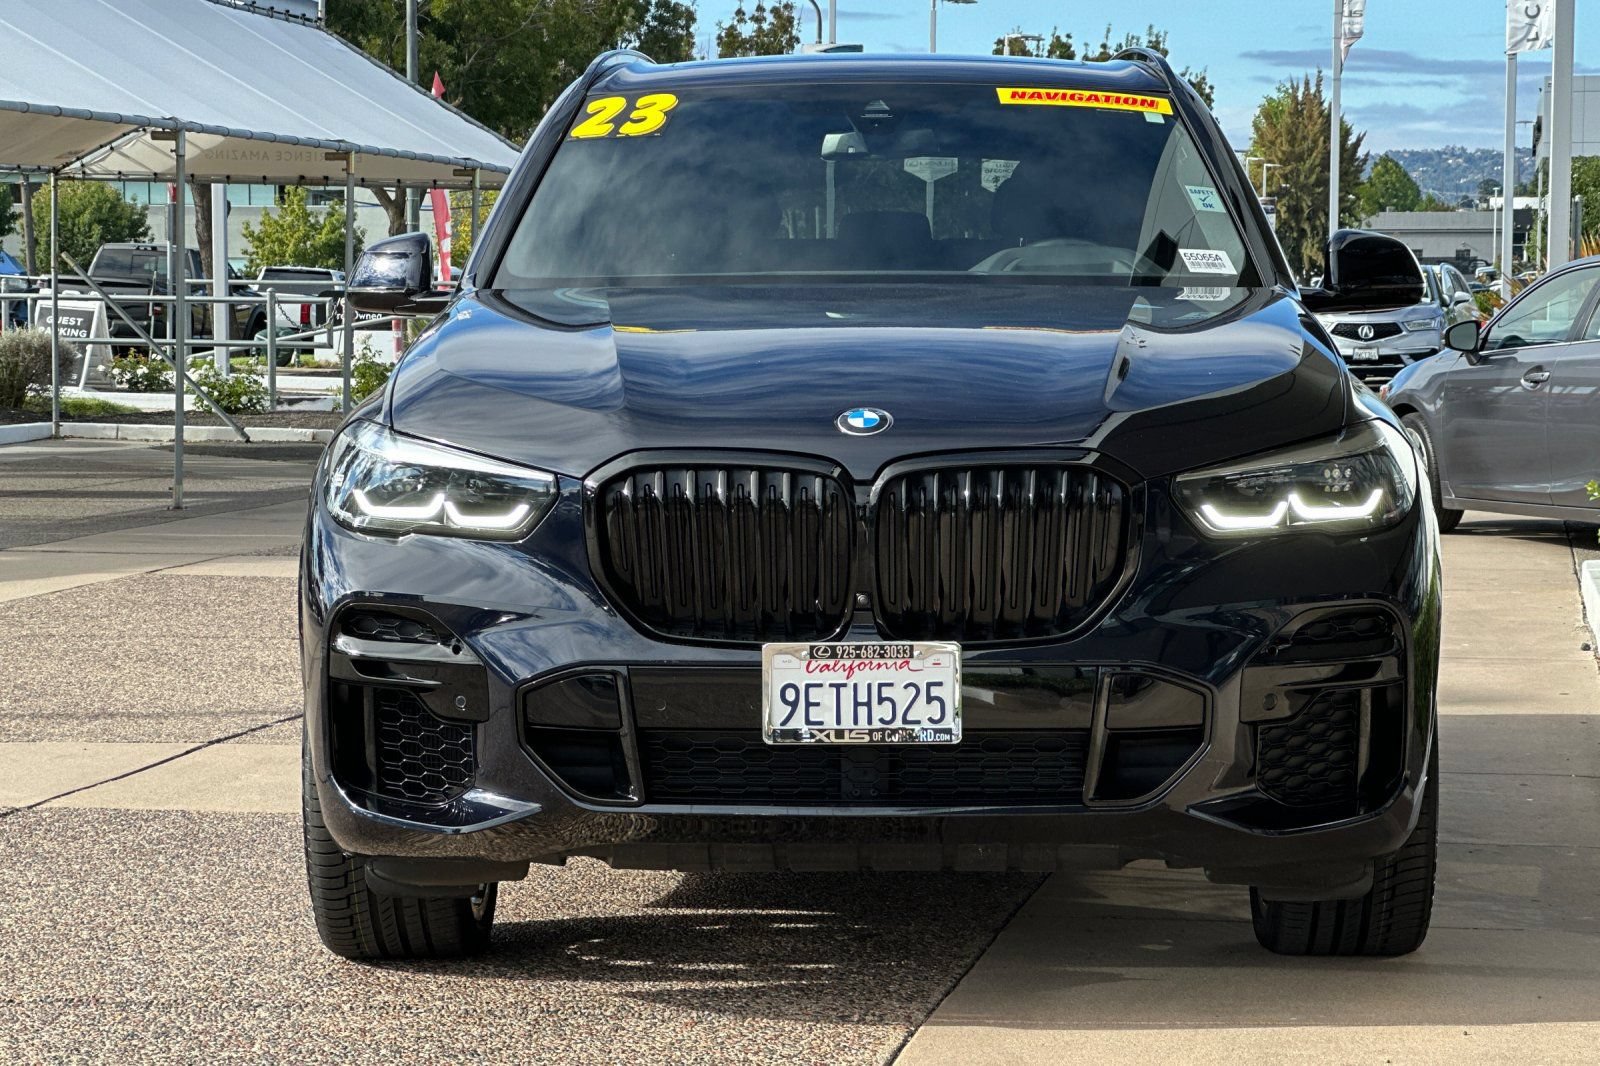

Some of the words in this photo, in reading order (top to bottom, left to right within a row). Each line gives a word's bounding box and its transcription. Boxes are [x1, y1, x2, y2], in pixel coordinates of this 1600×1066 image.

[1010, 90, 1159, 110] NAVIGATION
[570, 93, 678, 138] 23
[1183, 252, 1222, 261] 55065A
[38, 326, 88, 338] PAKING
[836, 644, 910, 659] 925-682-3033
[805, 659, 923, 680] California
[779, 681, 946, 726] 9ETH525
[872, 731, 883, 741] OF
